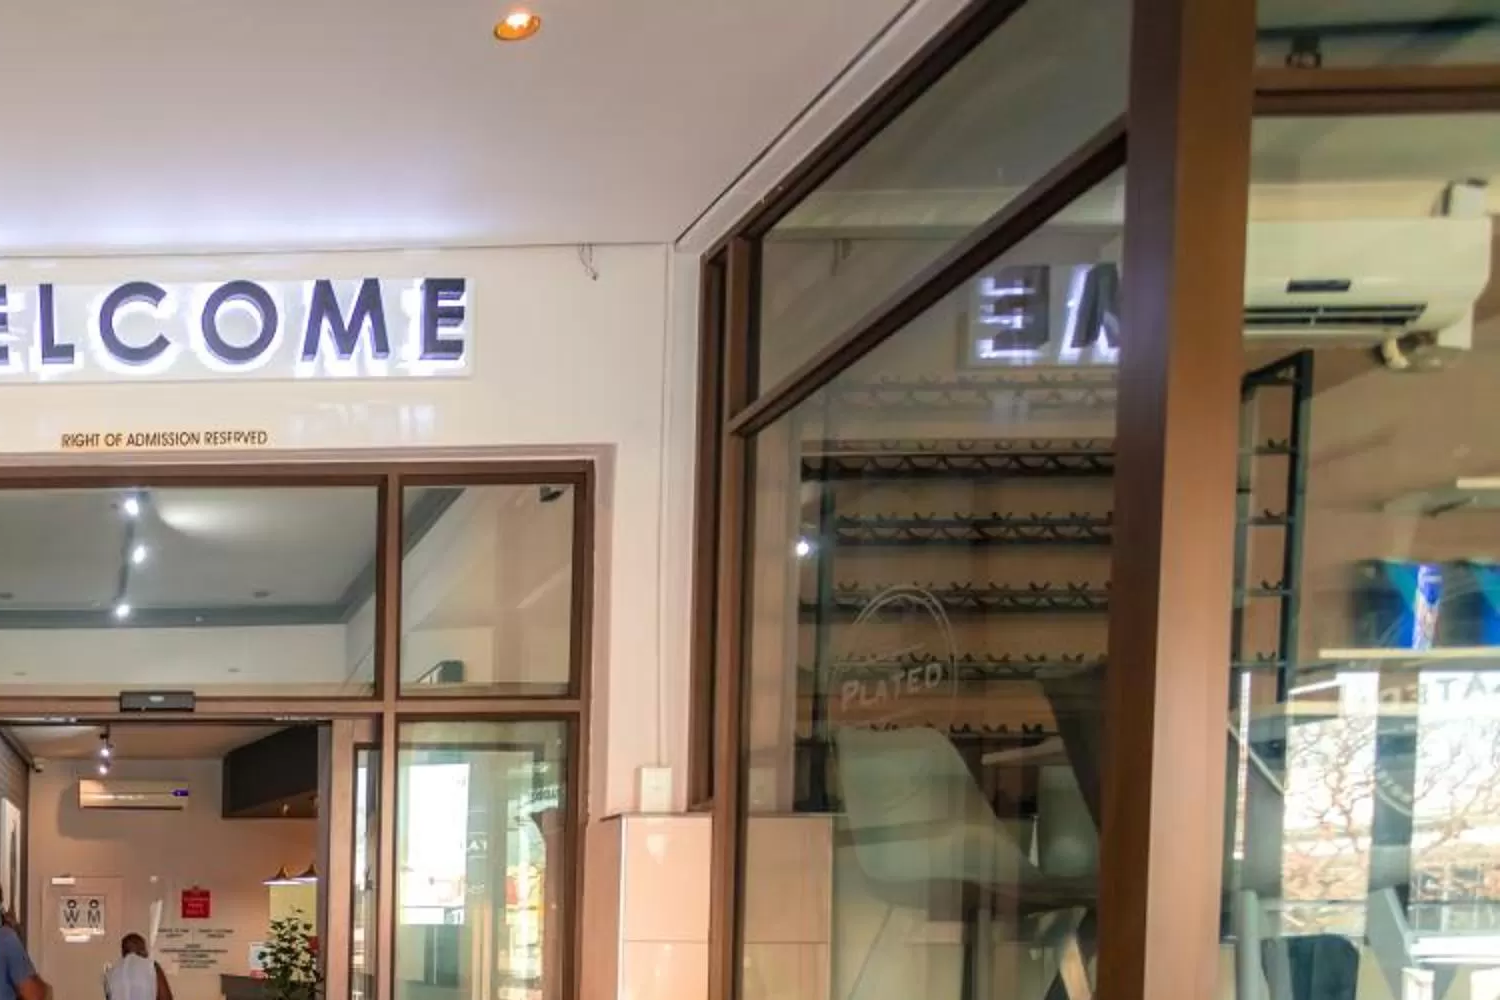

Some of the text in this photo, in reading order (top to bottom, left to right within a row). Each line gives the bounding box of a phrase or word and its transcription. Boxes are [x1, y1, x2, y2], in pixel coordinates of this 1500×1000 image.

[61, 433, 100, 447] RIGHT
[104, 433, 124, 447] OF
[126, 432, 199, 447] ADMISSION
[840, 662, 943, 713] PLATED
